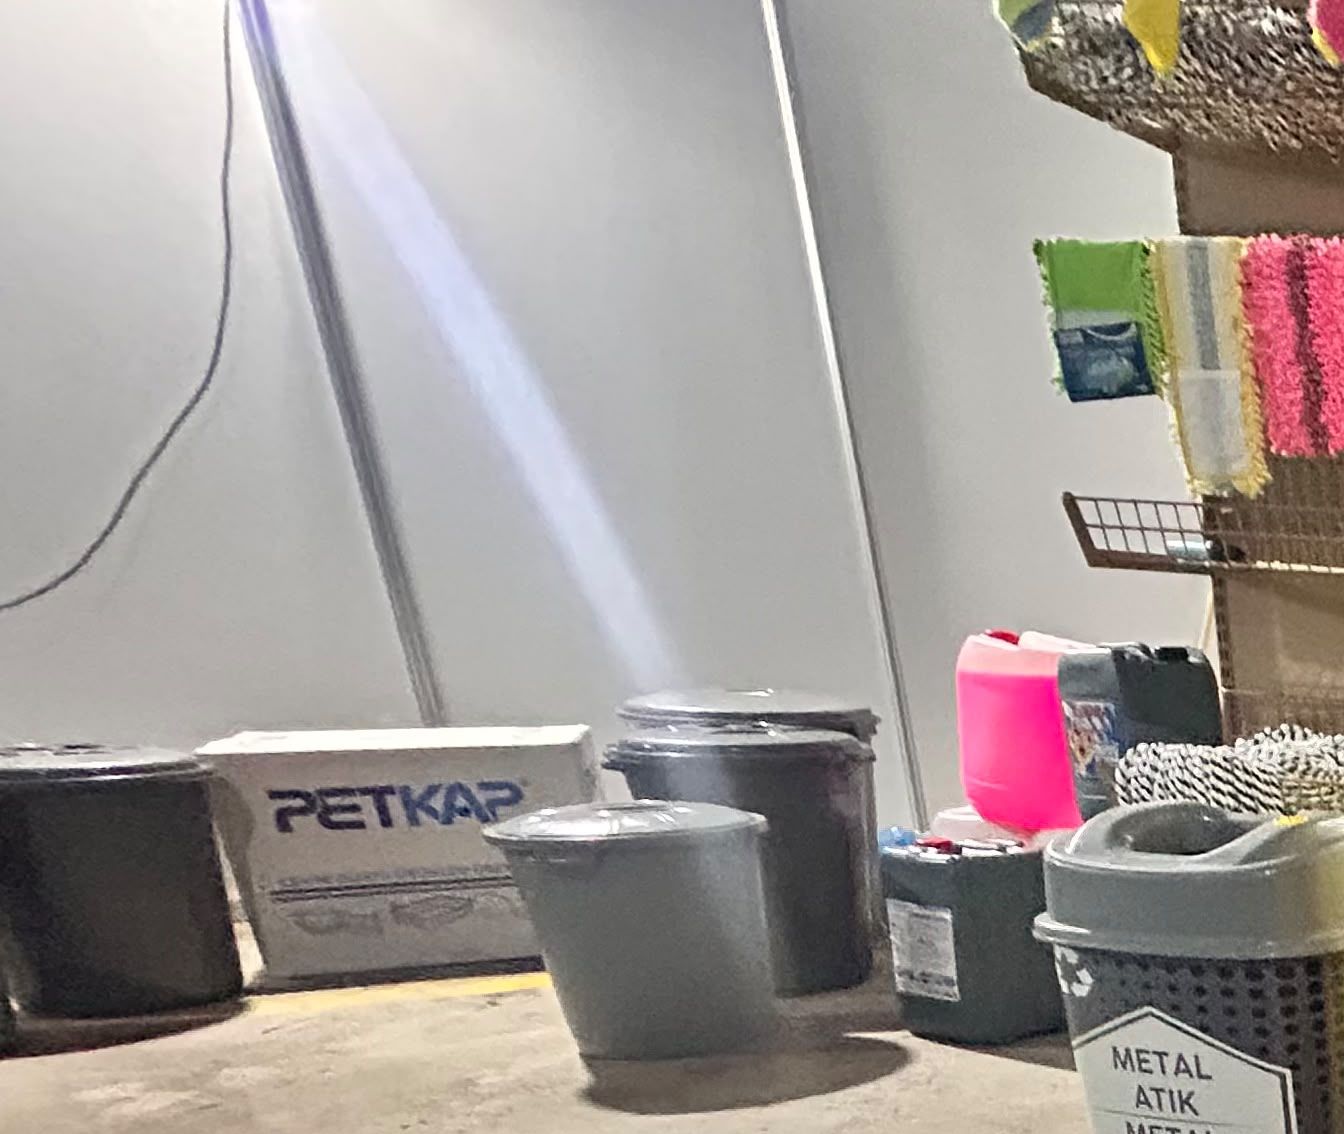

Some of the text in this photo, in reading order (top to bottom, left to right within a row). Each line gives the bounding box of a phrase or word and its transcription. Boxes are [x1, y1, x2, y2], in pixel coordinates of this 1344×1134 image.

[266, 780, 525, 833] PETKAP
[1112, 1047, 1213, 1080] METAL
[1136, 1085, 1199, 1116] ATIK
